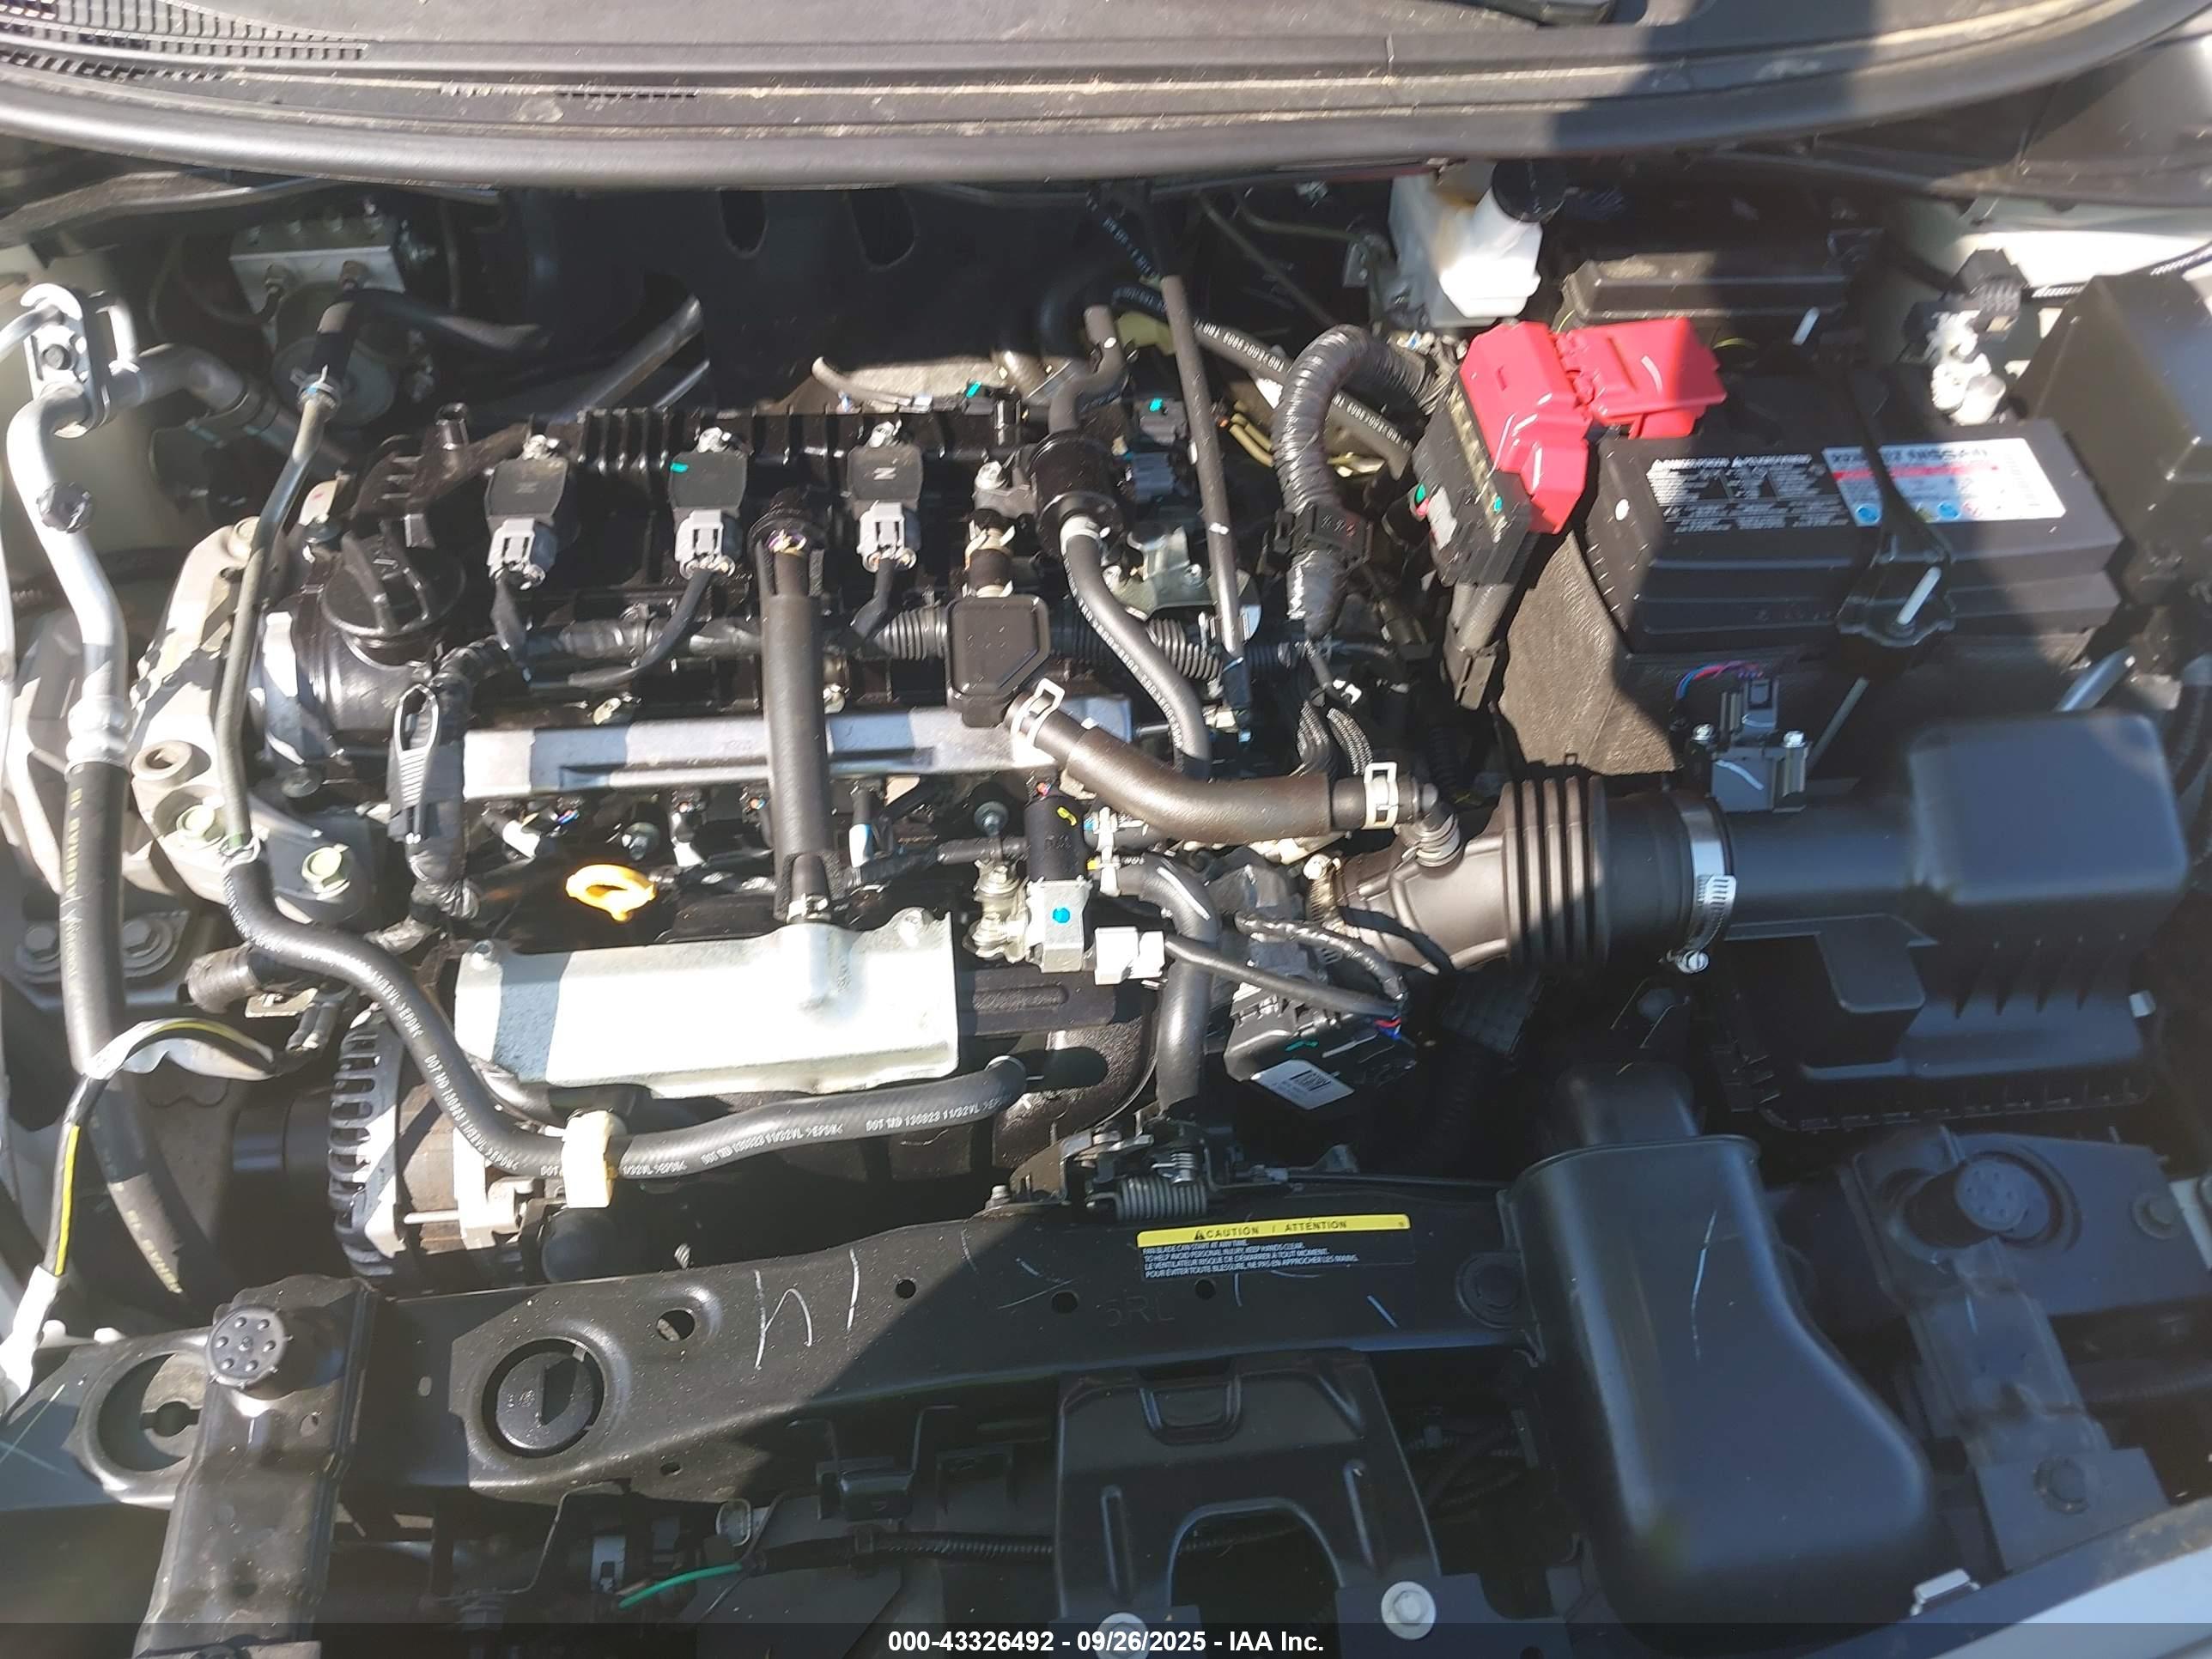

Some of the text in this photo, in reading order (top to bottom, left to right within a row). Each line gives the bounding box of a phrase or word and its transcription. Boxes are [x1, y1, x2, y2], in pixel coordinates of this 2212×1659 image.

[424, 1054, 443, 1073] DOT
[1206, 1225, 1259, 1238] CAUTION
[1285, 1220, 1347, 1232] ATTENTION
[1154, 1259, 1197, 1269] VENTILATEUR
[1146, 1269, 1164, 1278] POUR
